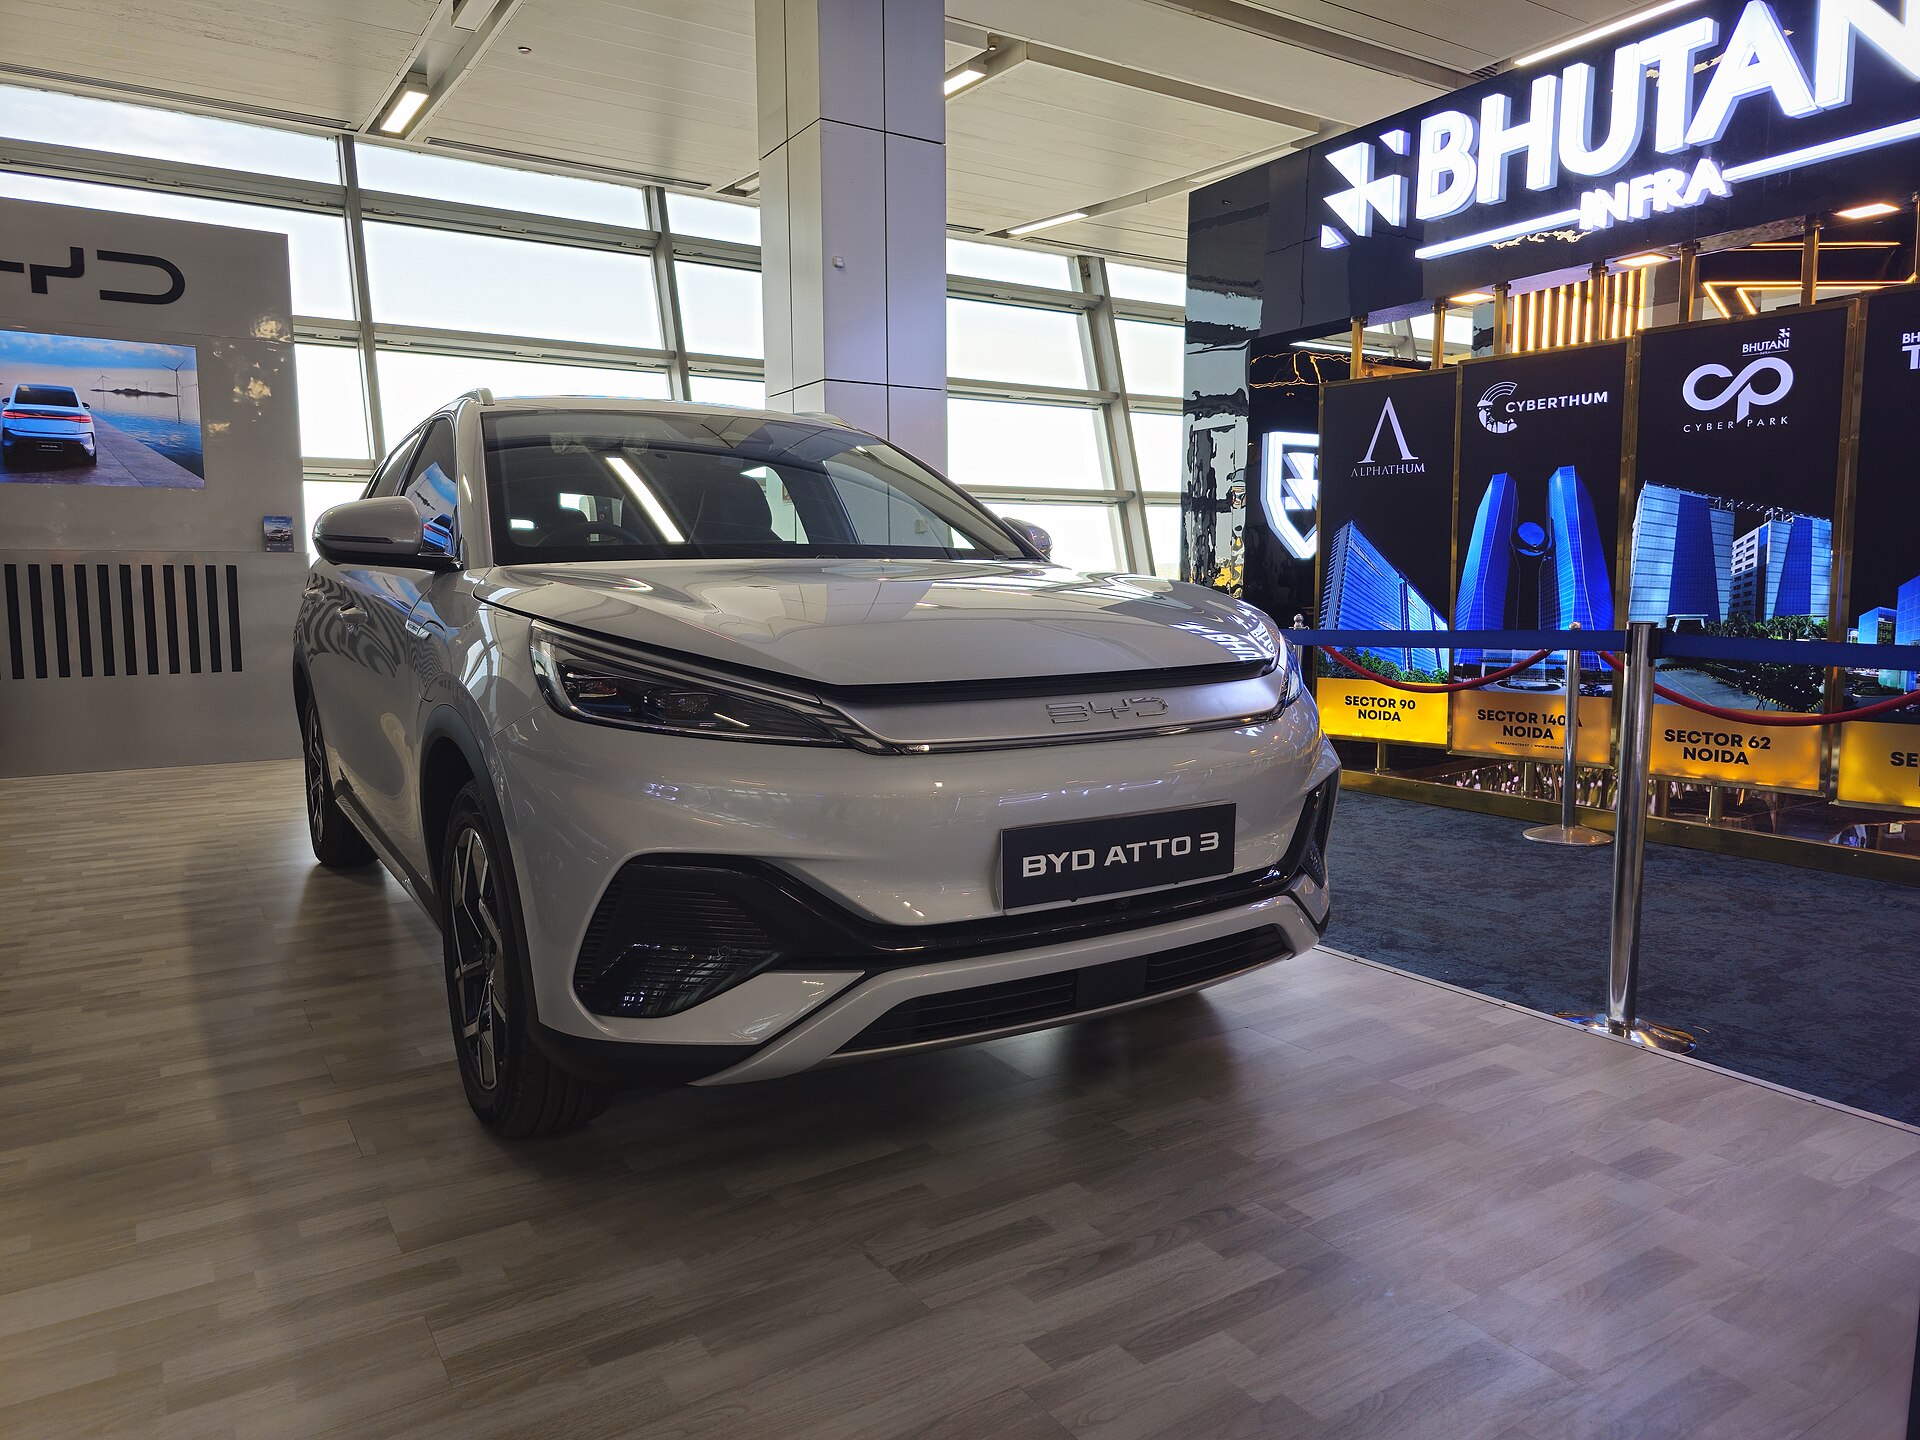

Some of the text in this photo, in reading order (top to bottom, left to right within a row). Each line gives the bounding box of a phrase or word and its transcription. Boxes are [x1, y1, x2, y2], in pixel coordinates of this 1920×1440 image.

[1579, 157, 1732, 231] INFRA
[0, 246, 185, 305] YD
[1742, 338, 1790, 354] BHUTANI
[1505, 391, 1608, 413] CYBERTHUM
[1683, 416, 1788, 433] CYBER PARK
[1350, 463, 1425, 477] ALPHATHUM
[1045, 696, 1169, 725] BYD
[1344, 695, 1416, 710] SECTOR 90
[1358, 708, 1402, 722] NOIDA
[1477, 709, 1538, 724] SECTOR
[1502, 725, 1555, 740] NOIDA
[1664, 729, 1771, 750] SECTOR 62
[1683, 747, 1750, 766] NOIDA
[1022, 831, 1220, 879] BYD ATTO 3
